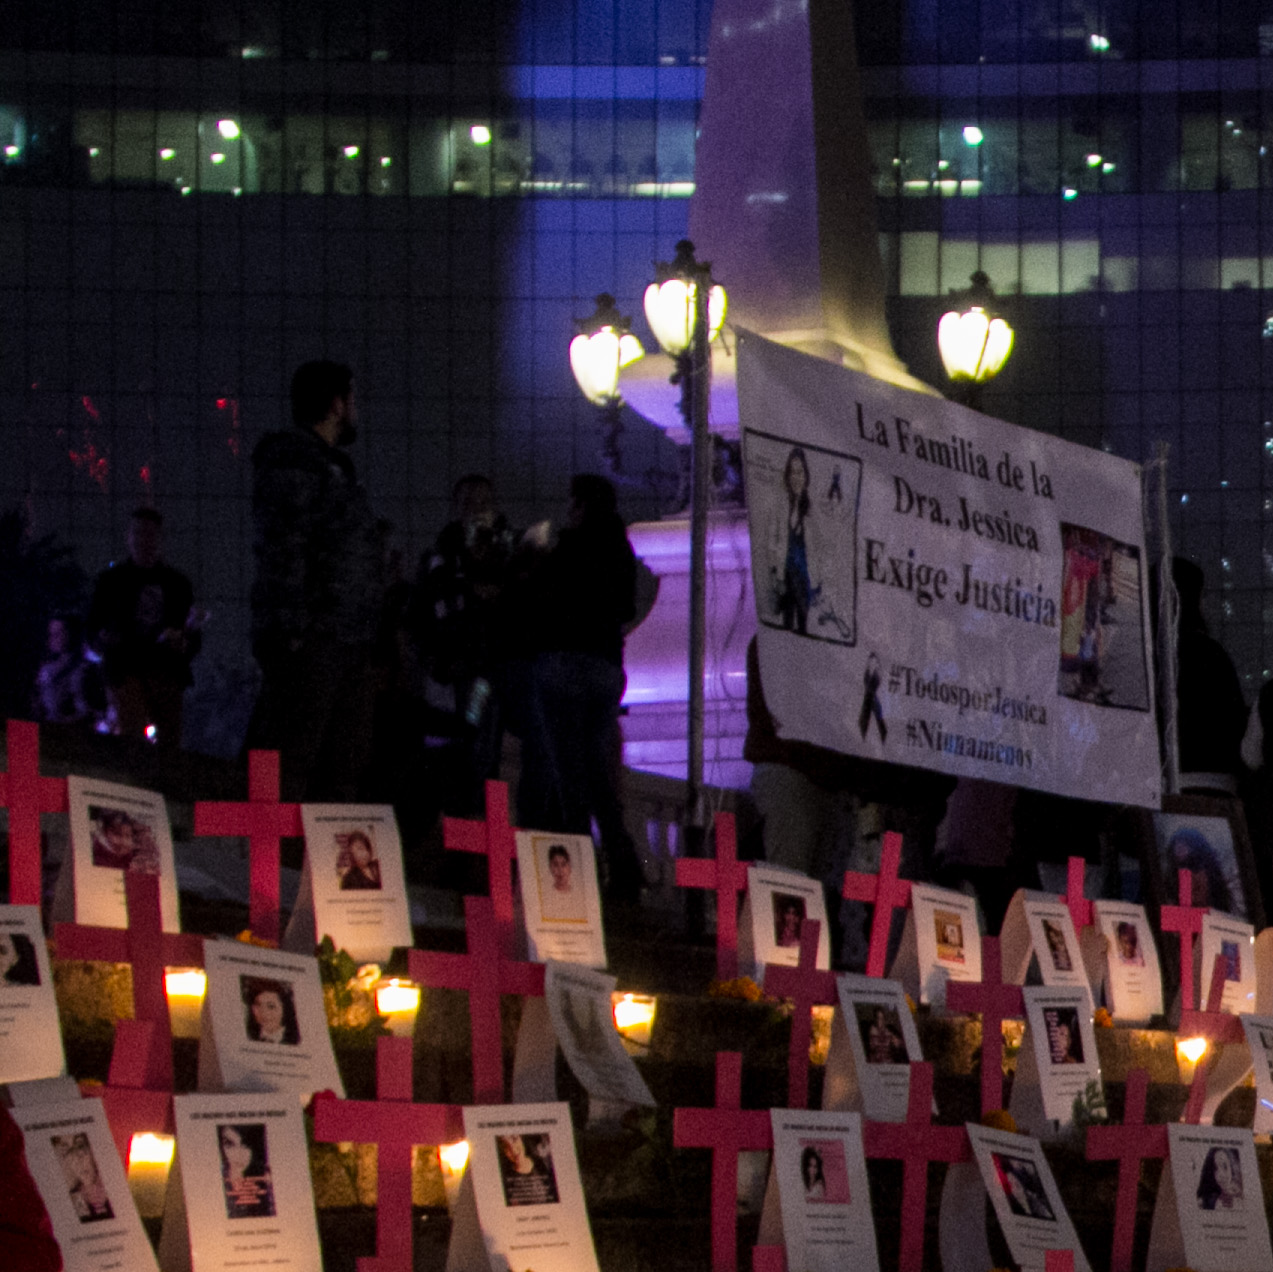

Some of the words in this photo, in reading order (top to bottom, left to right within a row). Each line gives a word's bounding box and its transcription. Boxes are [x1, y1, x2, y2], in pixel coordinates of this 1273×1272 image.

[854, 401, 890, 449] La
[900, 415, 990, 482] Familia
[996, 451, 1024, 488] de
[1030, 461, 1054, 500] la
[893, 475, 950, 528] Dra.
[958, 491, 1039, 552] Jessica
[862, 538, 948, 608] Exige
[956, 562, 1056, 628] Justicia
